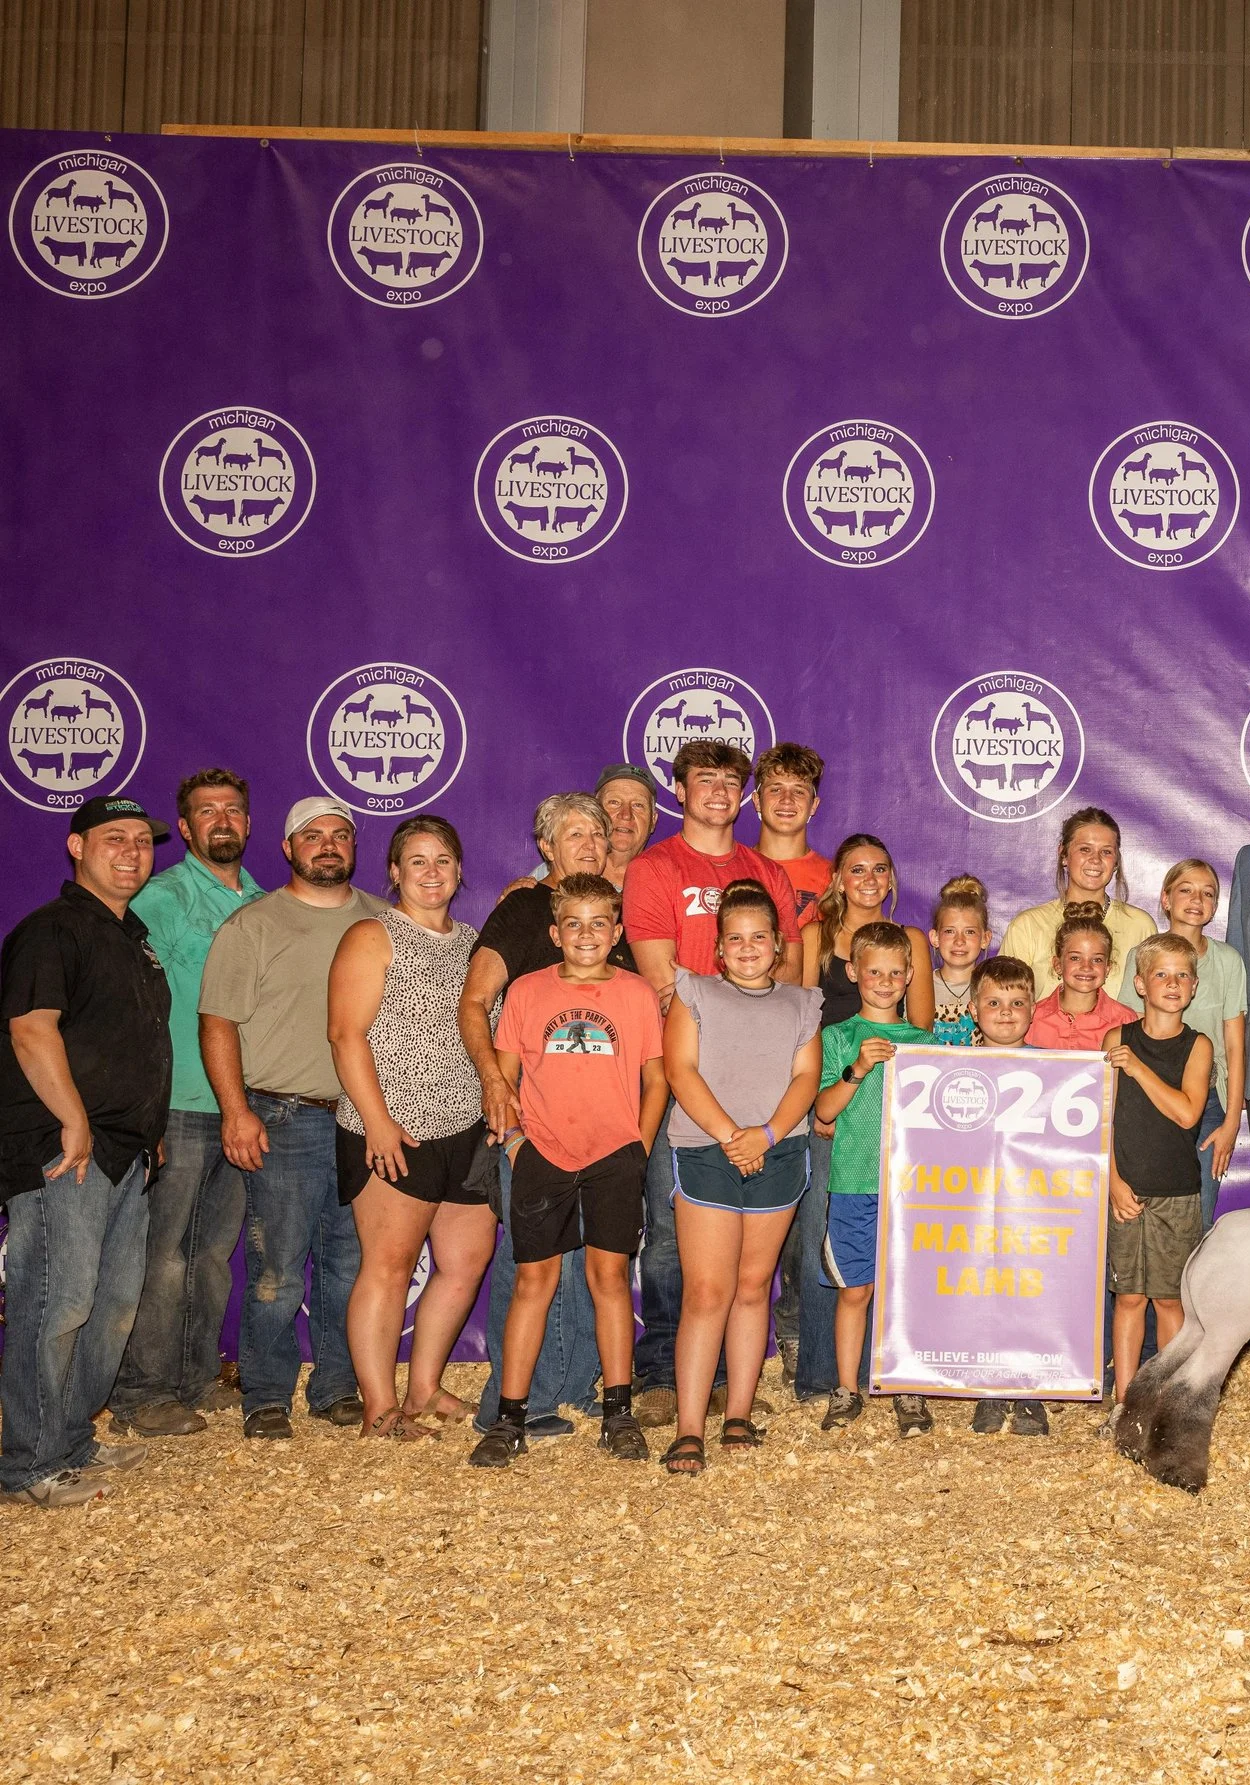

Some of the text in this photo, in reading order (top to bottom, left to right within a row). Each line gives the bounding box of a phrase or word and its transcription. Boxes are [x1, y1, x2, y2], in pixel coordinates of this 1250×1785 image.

[59, 154, 127, 173] michigan
[376, 168, 443, 188] michigan
[685, 177, 748, 195] michigan
[986, 178, 1048, 195] michigan
[34, 215, 144, 235] LIVESTOCK
[351, 227, 459, 246] LIVESTOCK
[662, 237, 764, 254] LIVESTOCK
[964, 239, 1066, 256] LIVESTOCK
[69, 281, 106, 295] expo
[387, 288, 422, 303] expo
[696, 301, 729, 313] expo
[999, 302, 1032, 315] expo
[209, 411, 275, 430] michigan
[523, 420, 587, 439] michigan
[830, 424, 894, 442] michigan
[1134, 426, 1198, 444] michigan
[184, 474, 292, 492] LIVESTOCK
[498, 480, 608, 499] LIVESTOCK
[807, 486, 911, 503] LIVESTOCK
[1112, 489, 1216, 505] LIVESTOCK
[219, 540, 254, 553] expo
[533, 546, 568, 559] expo
[842, 551, 876, 563] expo
[1148, 553, 1182, 566] expo
[36, 662, 104, 682] michigan
[357, 667, 424, 687] michigan
[669, 674, 735, 692] michigan
[978, 675, 1042, 694] michigan
[11, 727, 120, 744] LIVESTOCK
[332, 731, 445, 749] LIVESTOCK
[952, 739, 1061, 756] LIVESTOCK
[47, 795, 84, 808] expo
[367, 798, 403, 811] expo
[991, 804, 1026, 818] expo
[544, 1019, 558, 1041] PARTY
[559, 1013, 568, 1024] AT
[570, 1011, 582, 1020] THE
[585, 1012, 606, 1027] PARTY
[943, 1095, 987, 1105] LIVESTOCK
[912, 1223, 1074, 1256] MARKET
[936, 1266, 1044, 1298] LAMB
[914, 1351, 969, 1362] BELIEVE
